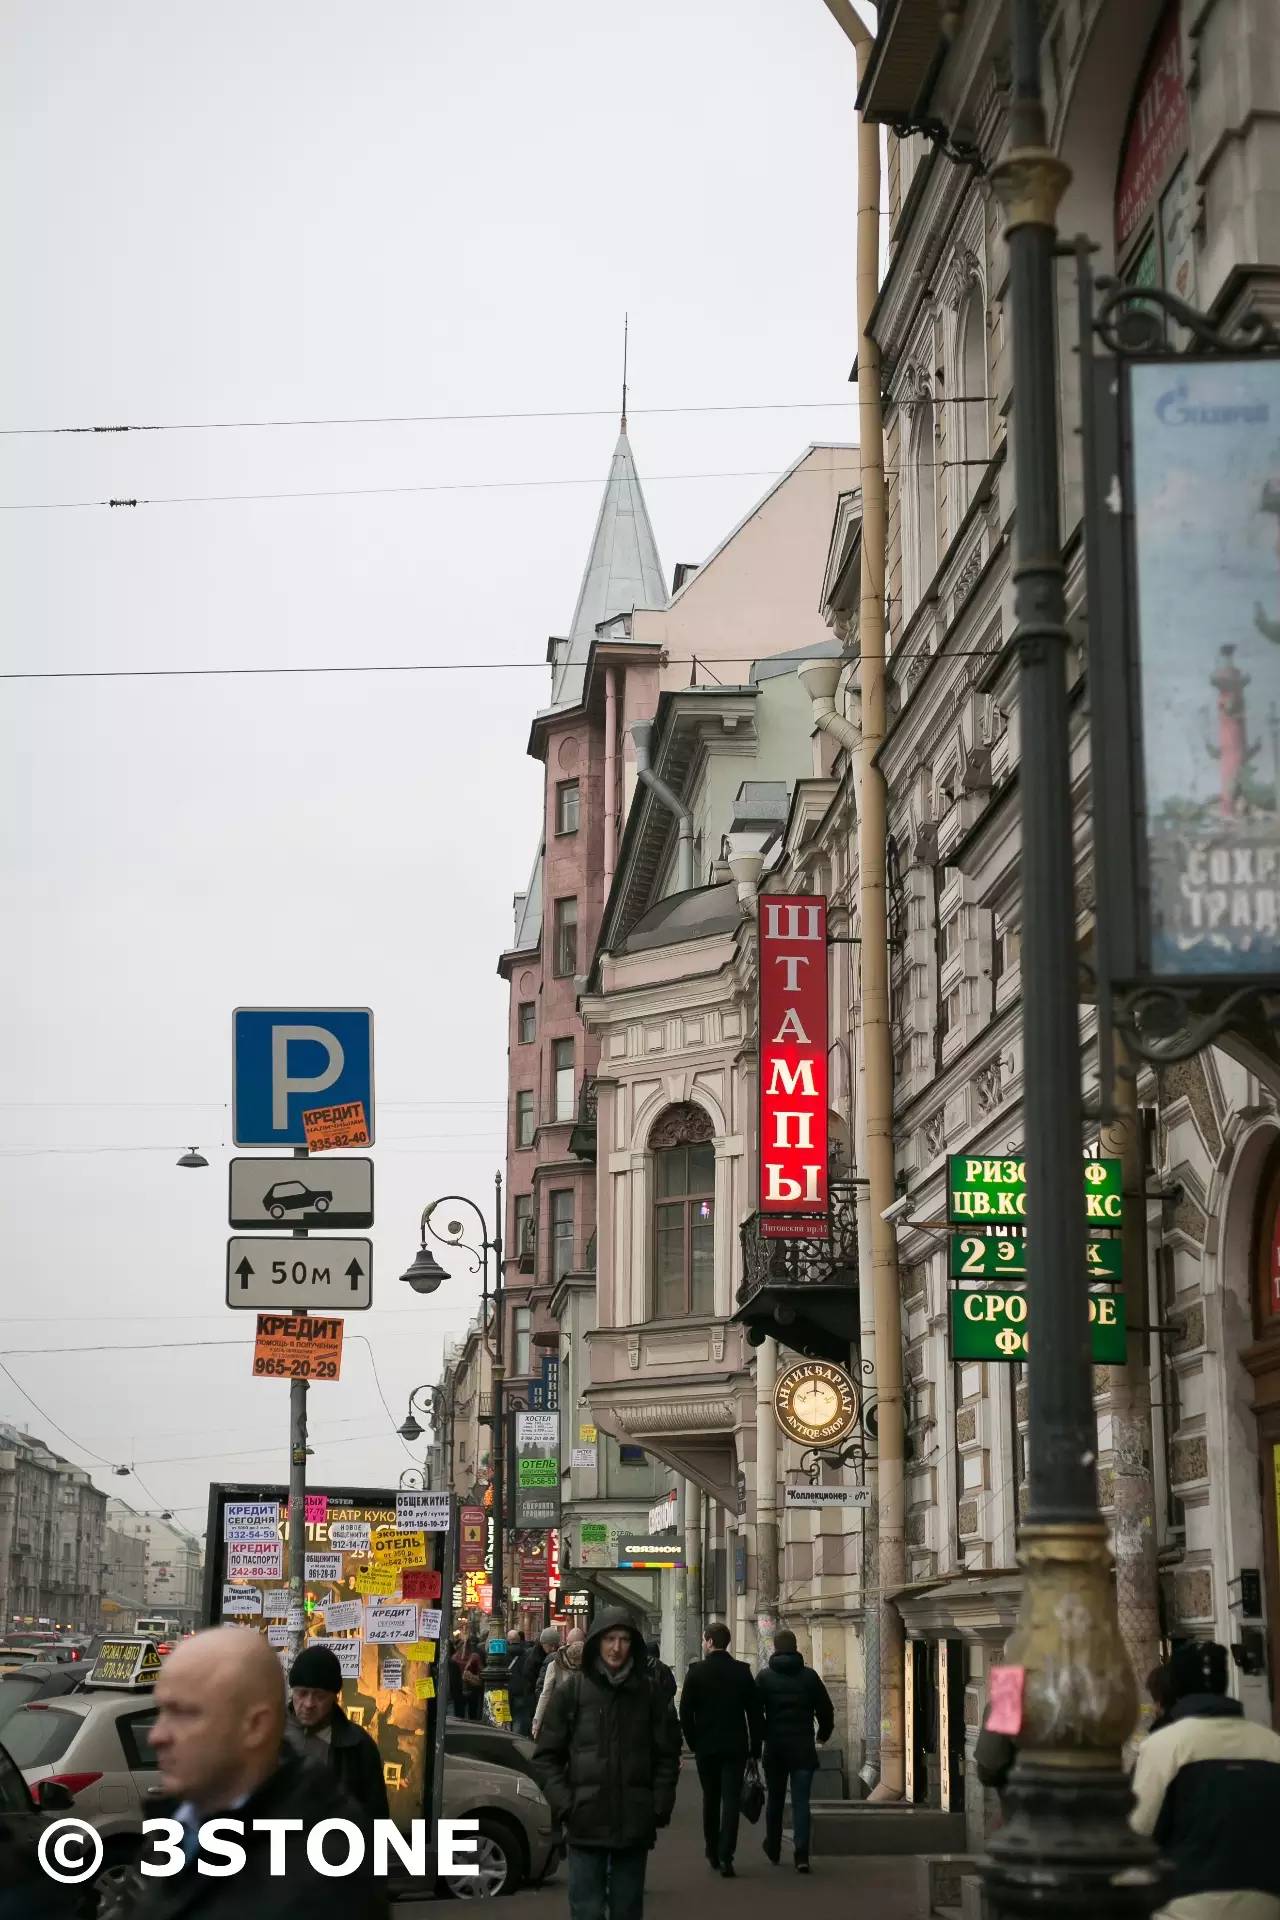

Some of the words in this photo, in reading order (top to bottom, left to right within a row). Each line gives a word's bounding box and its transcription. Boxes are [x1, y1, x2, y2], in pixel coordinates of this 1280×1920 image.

[1187, 845, 1280, 886] СОХР
[1189, 889, 1280, 937] ТРАД
[764, 904, 823, 1202] ШТАМПЫ
[272, 1025, 345, 1130] P
[304, 1104, 361, 1126] КРЕДИТ
[965, 1159, 1108, 1185] РИЗФ
[953, 1192, 1122, 1218] ЦВ.ККС
[960, 1238, 986, 1273] 2
[963, 1294, 1117, 1325] СРОЕ
[258, 1316, 342, 1341] КРЕДИТ
[254, 1357, 338, 1379] 965-20-29
[778, 1365, 853, 1415] АНТИКВАРИАТ
[786, 1415, 846, 1440] ANTIQE-SHOP
[522, 1460, 556, 1469] ОТЕЛЬ
[326, 1497, 354, 1506] OSTER
[397, 1495, 449, 1508] ОБЩЕЖИТИЕ
[229, 1506, 276, 1516] КРЕДИТ
[325, 1509, 362, 1521] ТЕАТР
[364, 1510, 396, 1522] КУКО
[228, 1516, 275, 1525] СЕГОДНЯ
[228, 1531, 275, 1539] 332-54-59
[232, 1544, 279, 1554] КРЕДИТ
[332, 1540, 369, 1549] 912-14-77
[376, 1538, 421, 1551] ОТЕЛЬ
[231, 1555, 241, 1565] ПО
[242, 1555, 279, 1565] ПАСПОРТУ
[371, 1609, 412, 1619] КРЕДИТ
[369, 1630, 415, 1639] 942-17-48
[100, 1644, 125, 1660] ПРОКАТ
[122, 1645, 141, 1660] АВТО
